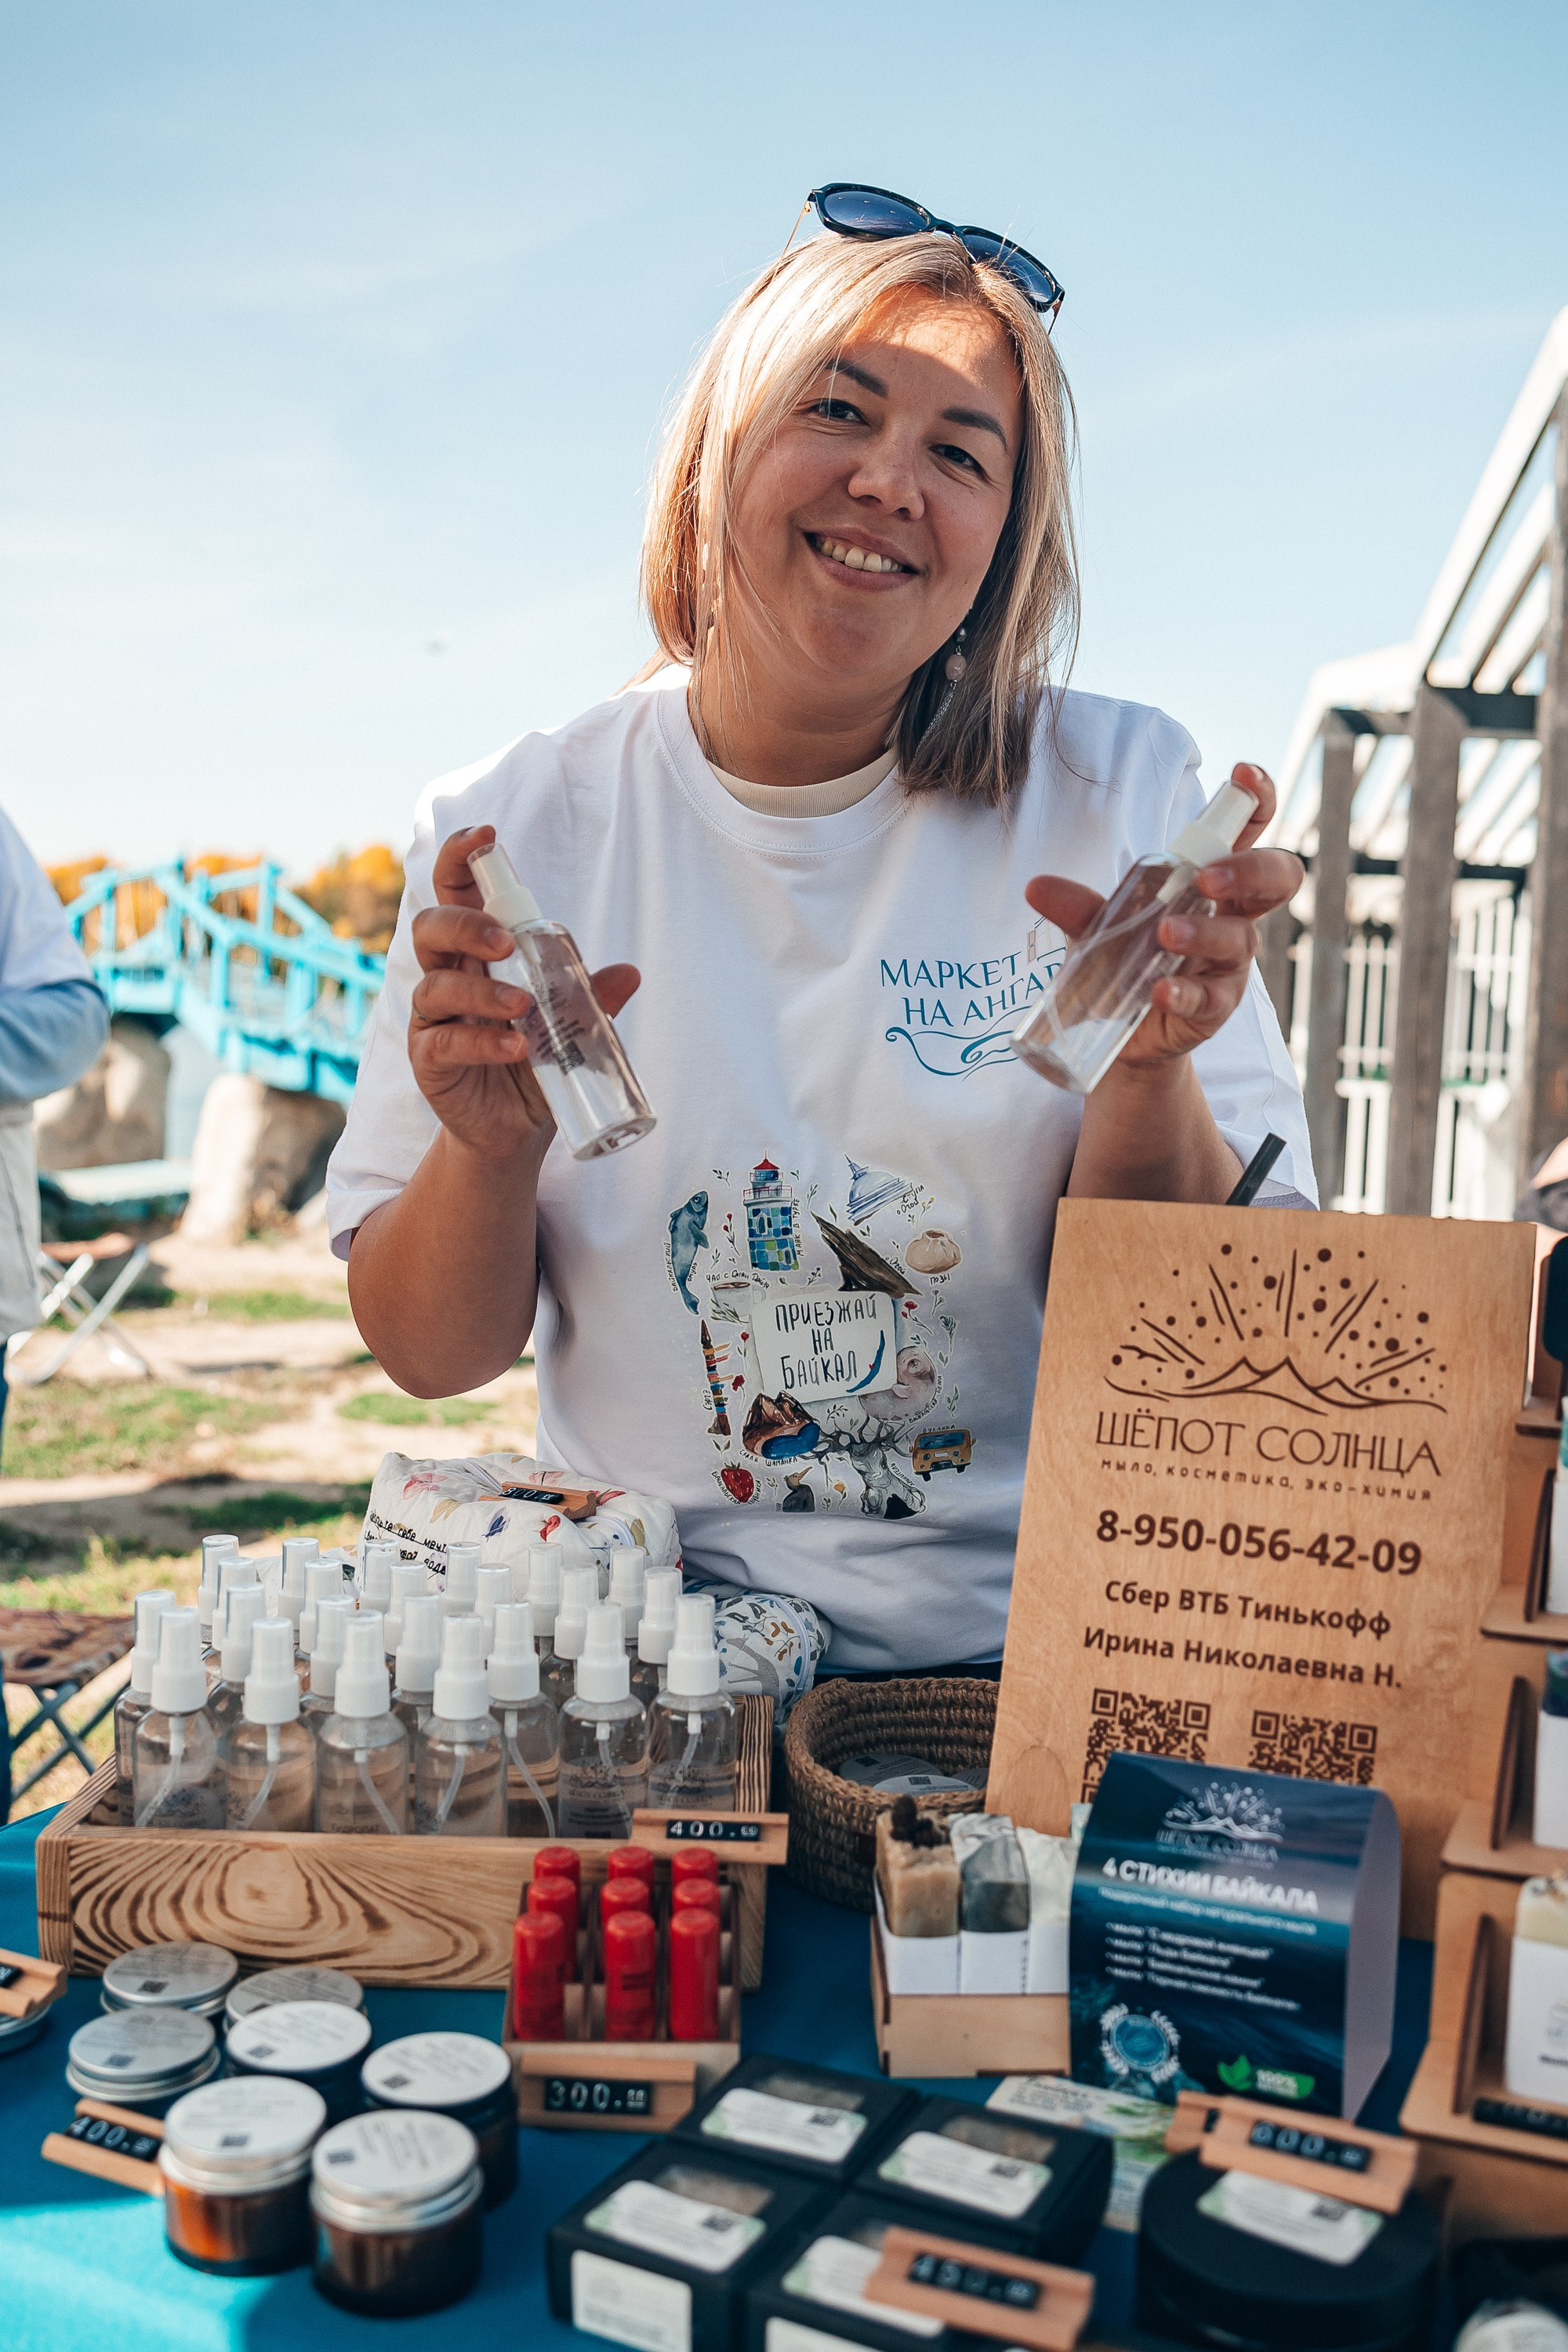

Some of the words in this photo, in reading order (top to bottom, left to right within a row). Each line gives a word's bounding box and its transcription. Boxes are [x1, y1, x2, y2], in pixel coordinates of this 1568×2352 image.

[880, 951, 1022, 989] МАРКЕТ
[902, 997, 954, 1026] НА
[902, 1185, 925, 1203] СТУПА
[793, 1234, 804, 1256] МАЯК
[930, 1273, 950, 1286] ПОЗЫ
[775, 1293, 877, 1333] ПРИЕЗЖАЙ
[811, 1327, 834, 1356] НА
[780, 1350, 858, 1390] БАЙКАЛ
[923, 1425, 956, 1433] БУХАНКА
[1096, 1408, 1245, 1457] ШЁПОТ
[1258, 1425, 1441, 1480] СОЛНЦА
[765, 1457, 798, 1467] ШАМАНКА
[1101, 1460, 1157, 1477] мыло,
[1166, 1465, 1294, 1490] косметика,
[398, 1529, 416, 1541] себе
[423, 1538, 447, 1554] мечт
[1096, 1509, 1422, 1575] 8-950-056-42-09
[1105, 1581, 1170, 1613] Сбер
[1179, 1589, 1229, 1616] ВТБ
[1239, 1596, 1391, 1640] Тинькофф
[1083, 1628, 1174, 1659] Ирина
[1184, 1639, 1364, 1685] Николаевна
[1374, 1664, 1403, 1688] Н.
[1102, 1857, 1116, 1878] 4
[1211, 1875, 1319, 1914] БАЙКАЛА
